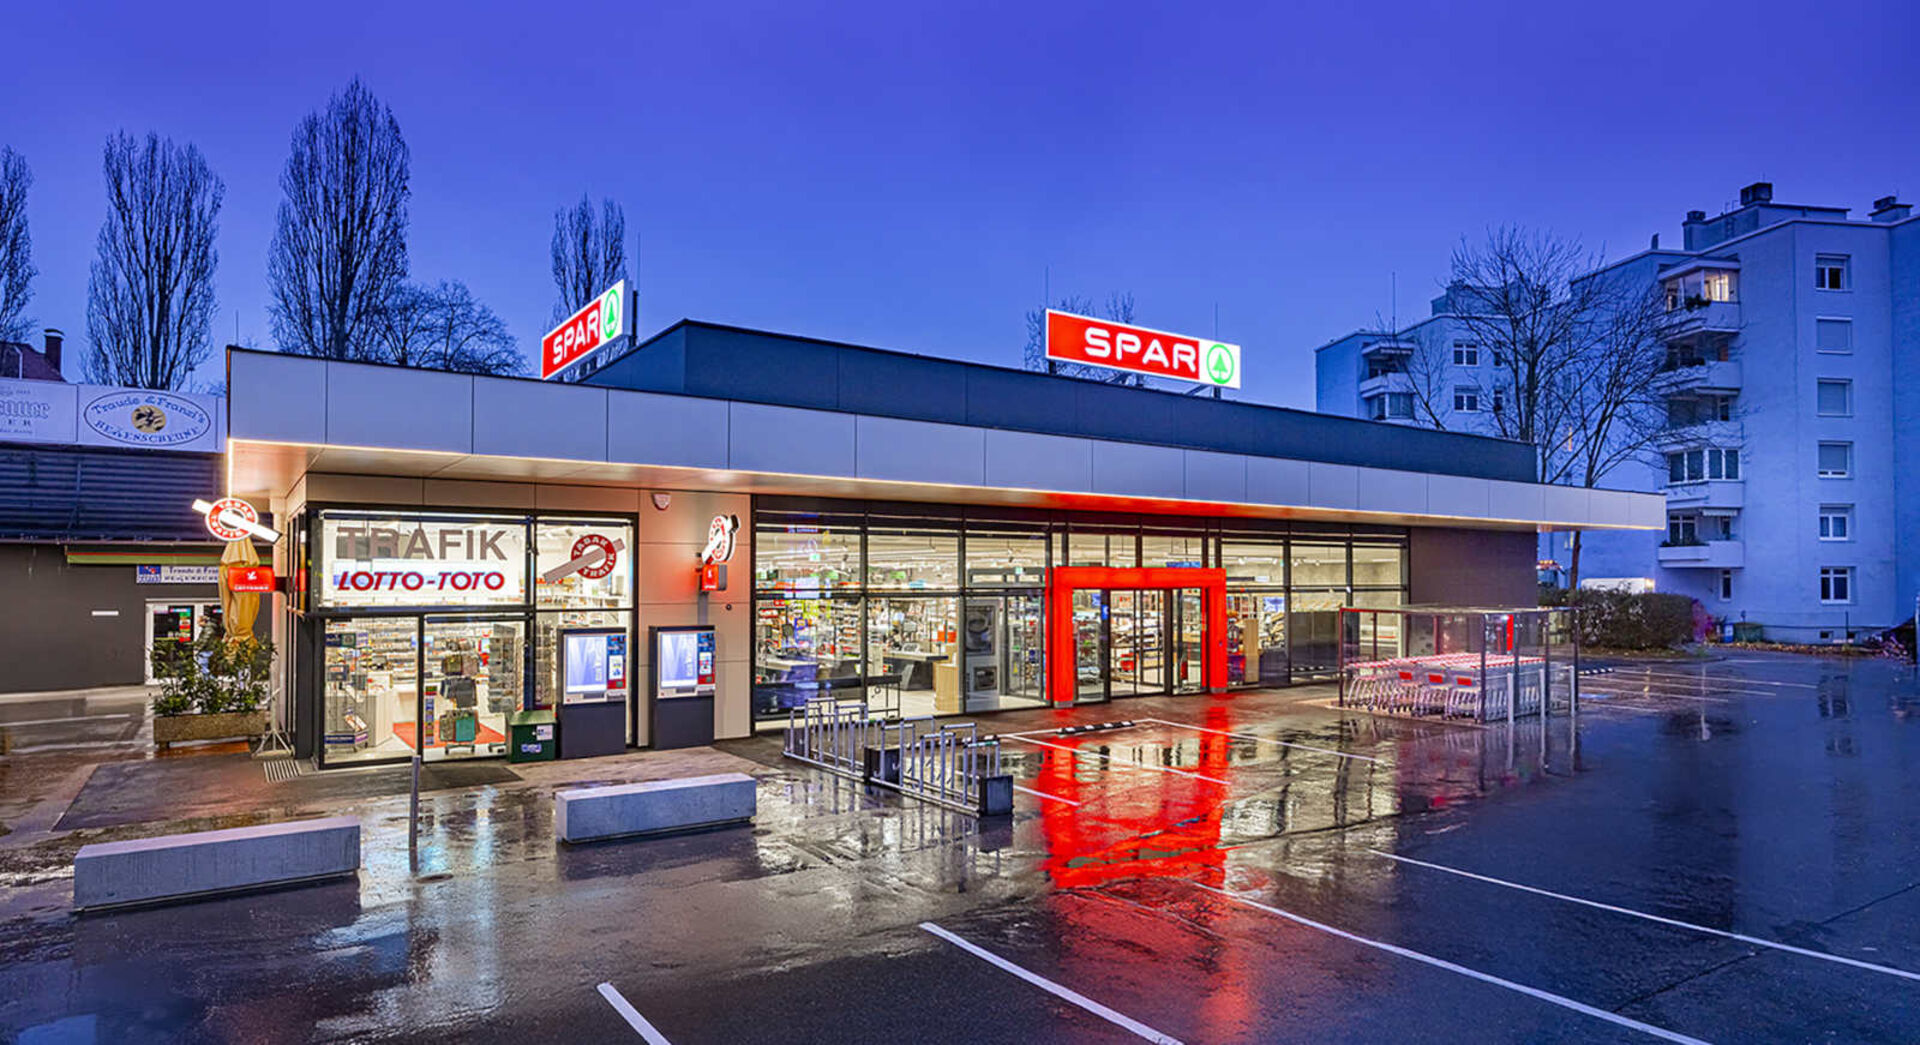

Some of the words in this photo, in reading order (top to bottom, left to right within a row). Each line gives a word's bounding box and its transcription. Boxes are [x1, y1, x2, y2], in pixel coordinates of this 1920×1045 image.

[553, 309, 599, 365] SPAR
[1084, 327, 1196, 373] SPAR
[91, 396, 139, 414] Traude
[145, 396, 156, 405] &
[337, 526, 507, 561] TRAFIK
[573, 536, 608, 557] TABAK
[583, 553, 615, 577] TRAFIK
[338, 571, 505, 591] LOTTO-TOTO
